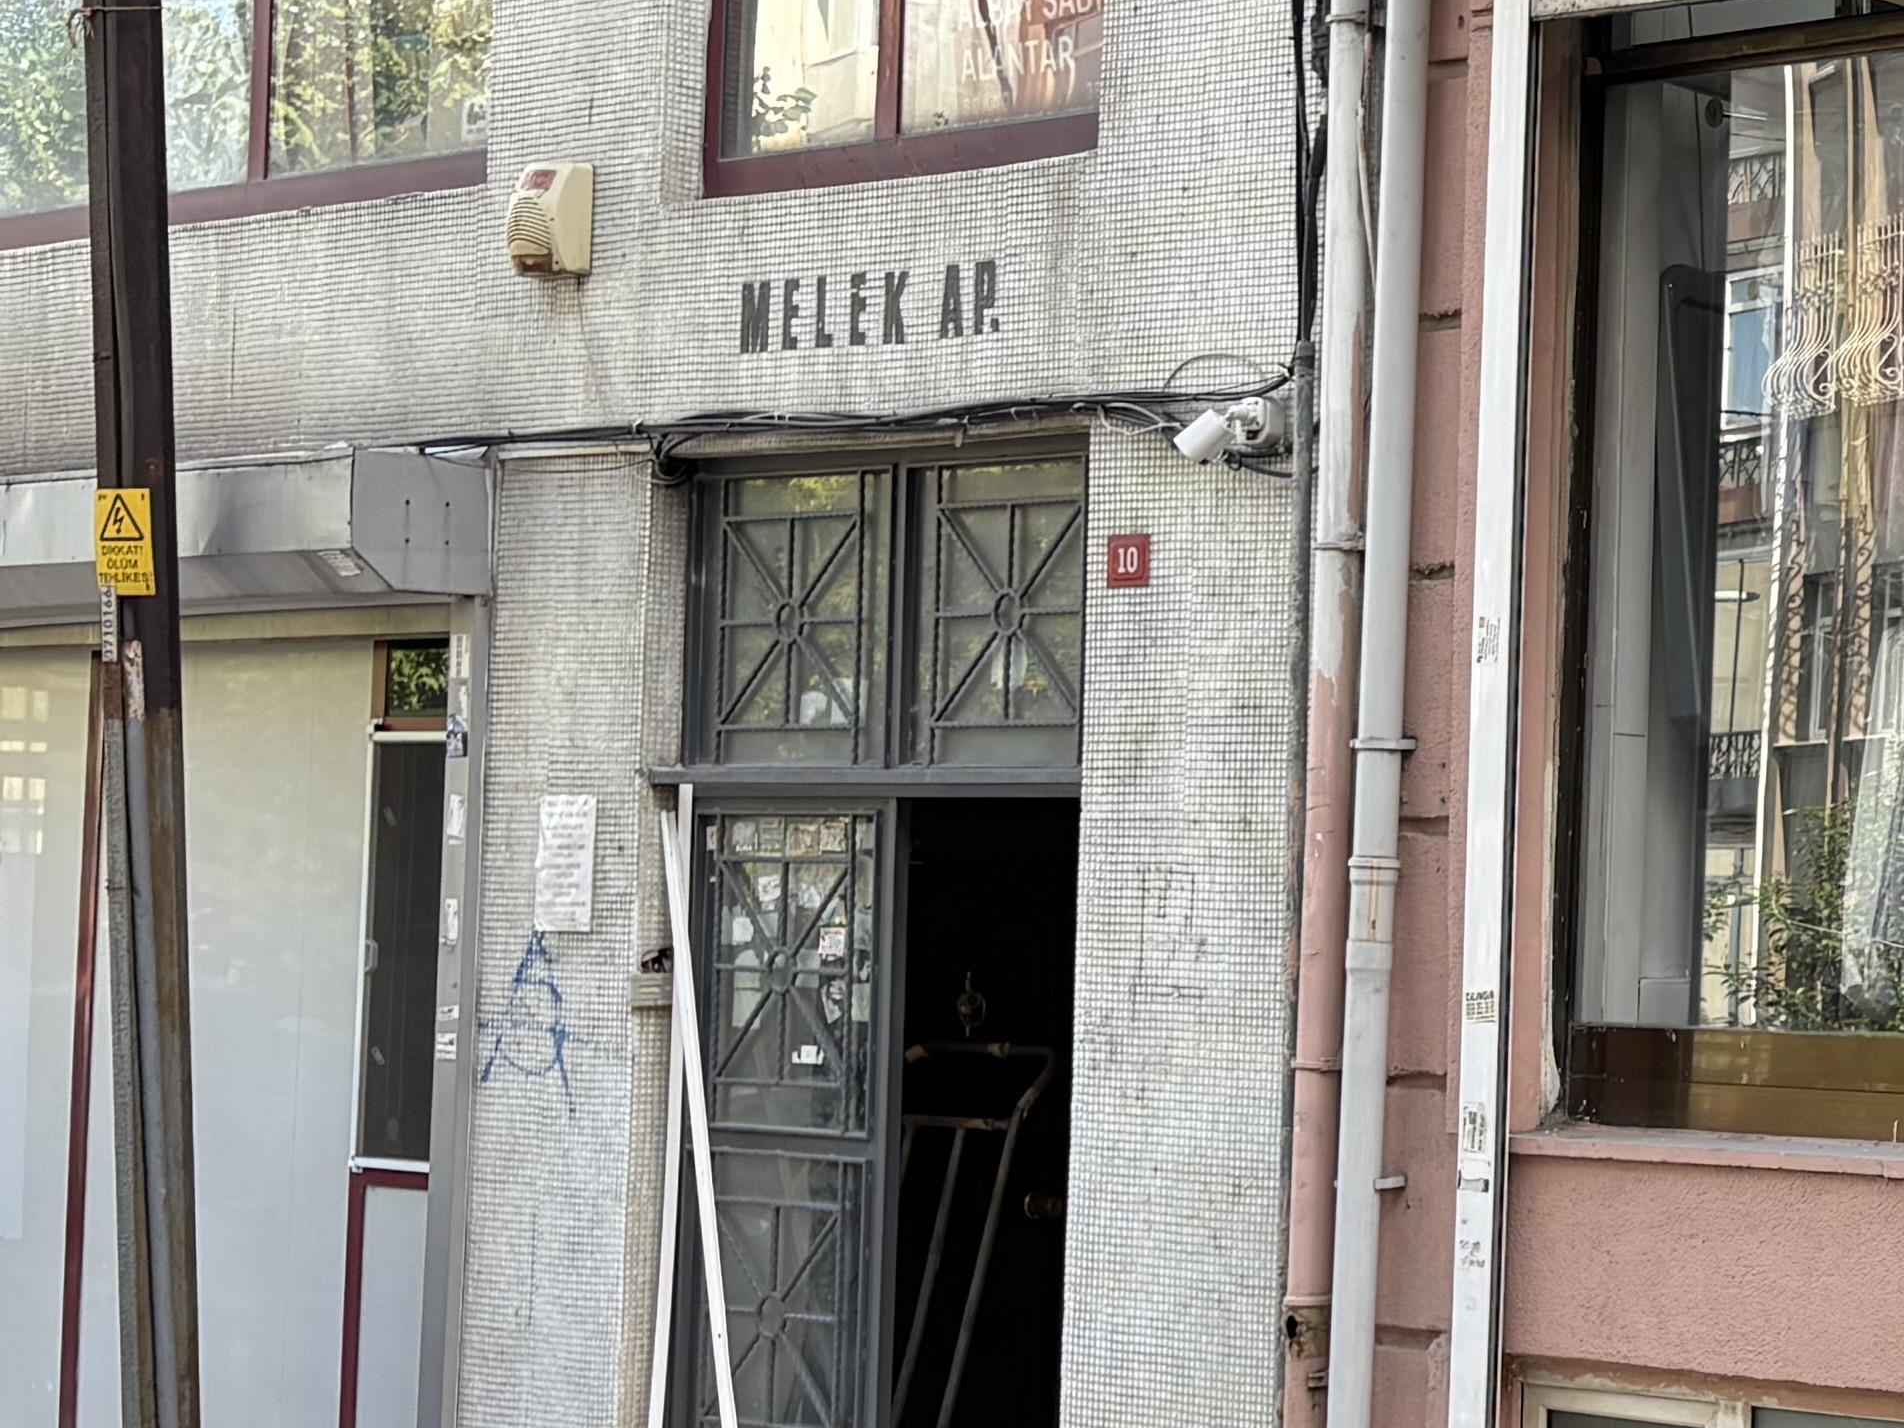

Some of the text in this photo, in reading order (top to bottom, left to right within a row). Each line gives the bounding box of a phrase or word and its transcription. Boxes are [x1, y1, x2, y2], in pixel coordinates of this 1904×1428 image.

[960, 34, 1075, 85] ALANTAR
[740, 260, 1000, 354] MELEK AP.
[1117, 546, 1139, 574] 10
